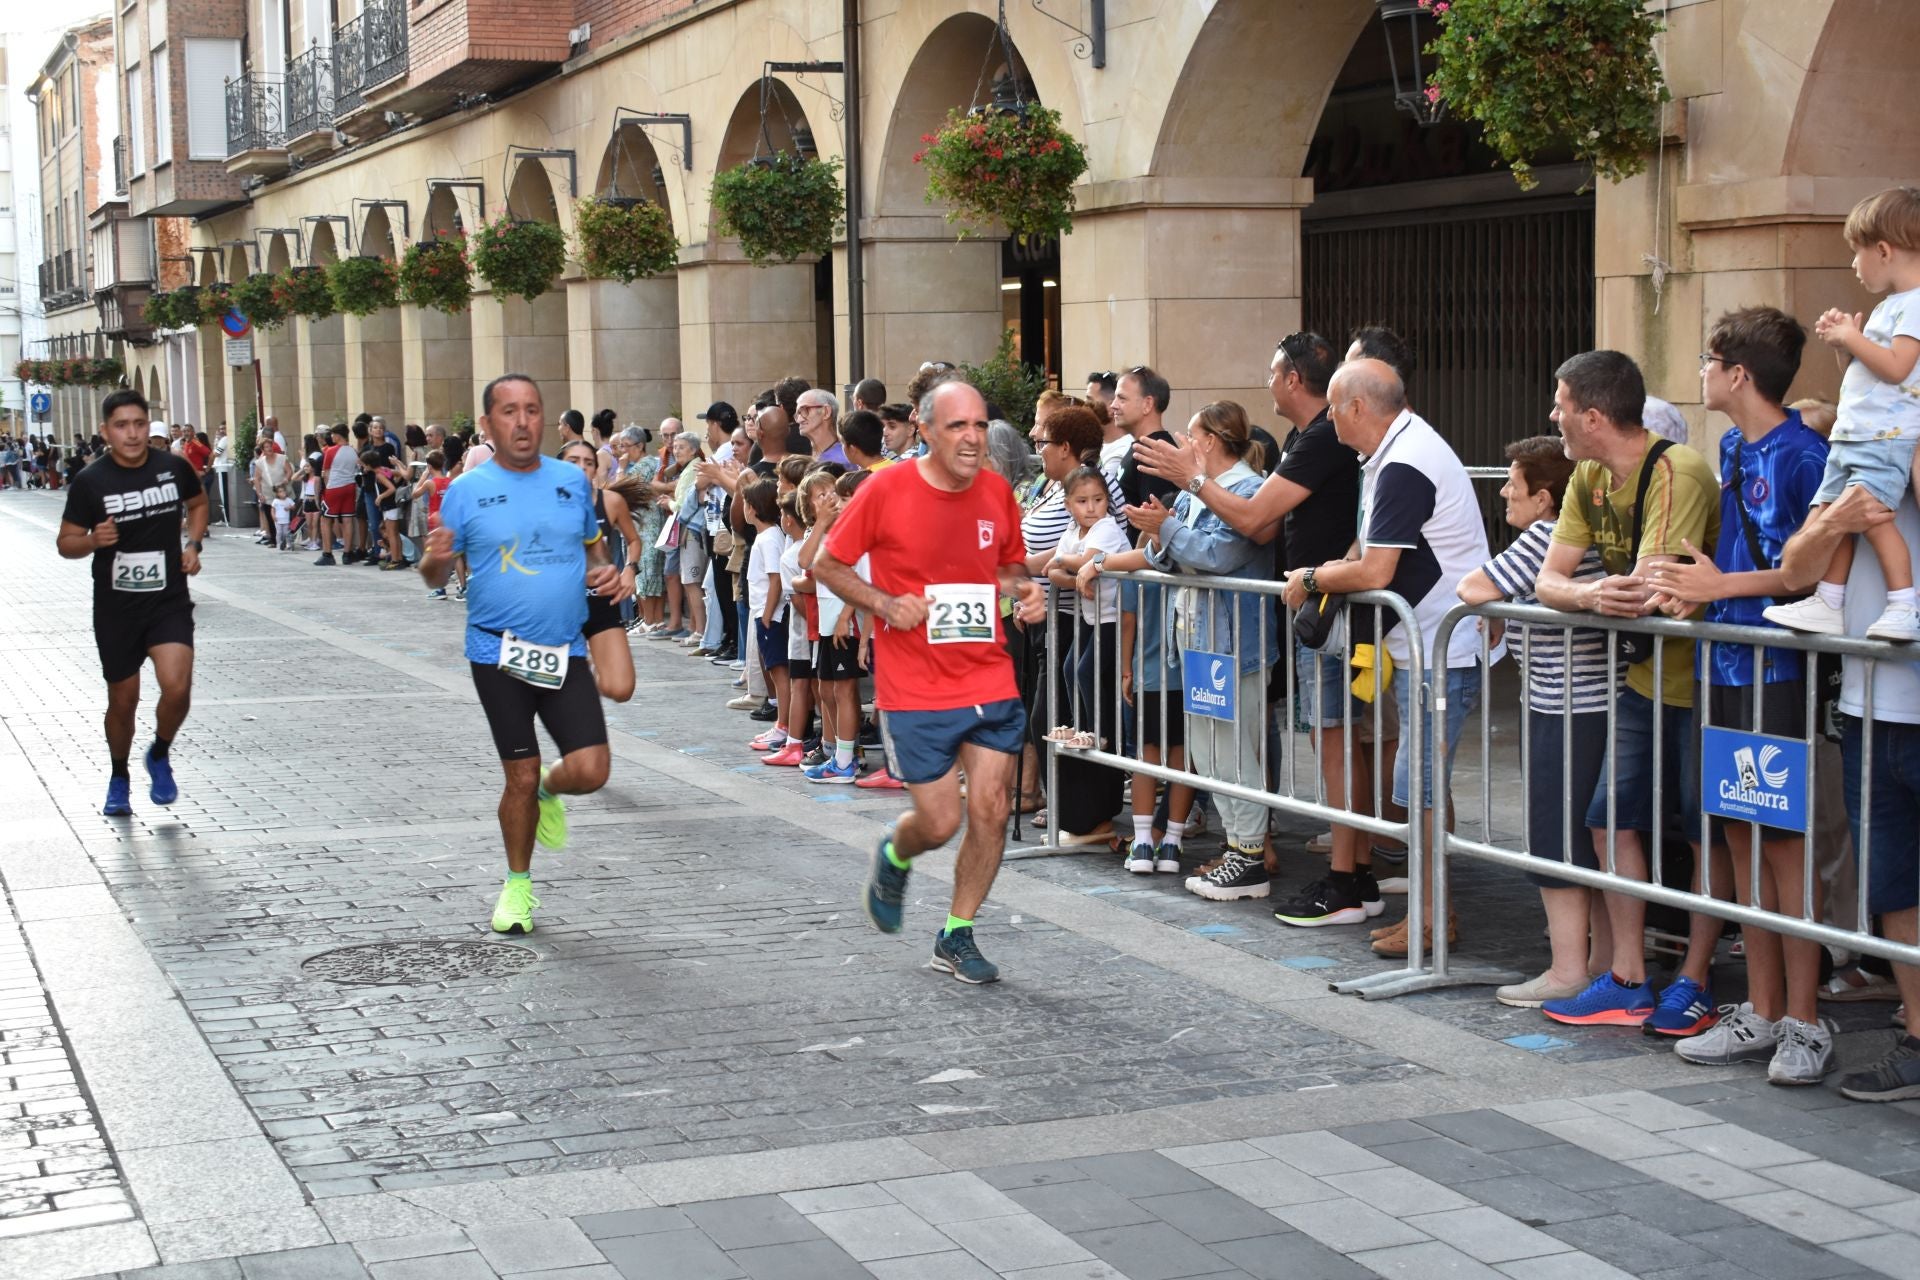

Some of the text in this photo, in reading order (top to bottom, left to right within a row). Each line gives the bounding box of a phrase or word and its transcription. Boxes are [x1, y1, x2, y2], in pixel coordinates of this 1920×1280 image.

[118, 564, 160, 581] 264
[935, 602, 987, 626] 233
[508, 646, 559, 673] 289
[1191, 686, 1227, 707] Calahorra
[1719, 779, 1790, 811] Calahorra
[1718, 800, 1758, 816] Ayuntamiento
[1239, 842, 1264, 850] NEV
